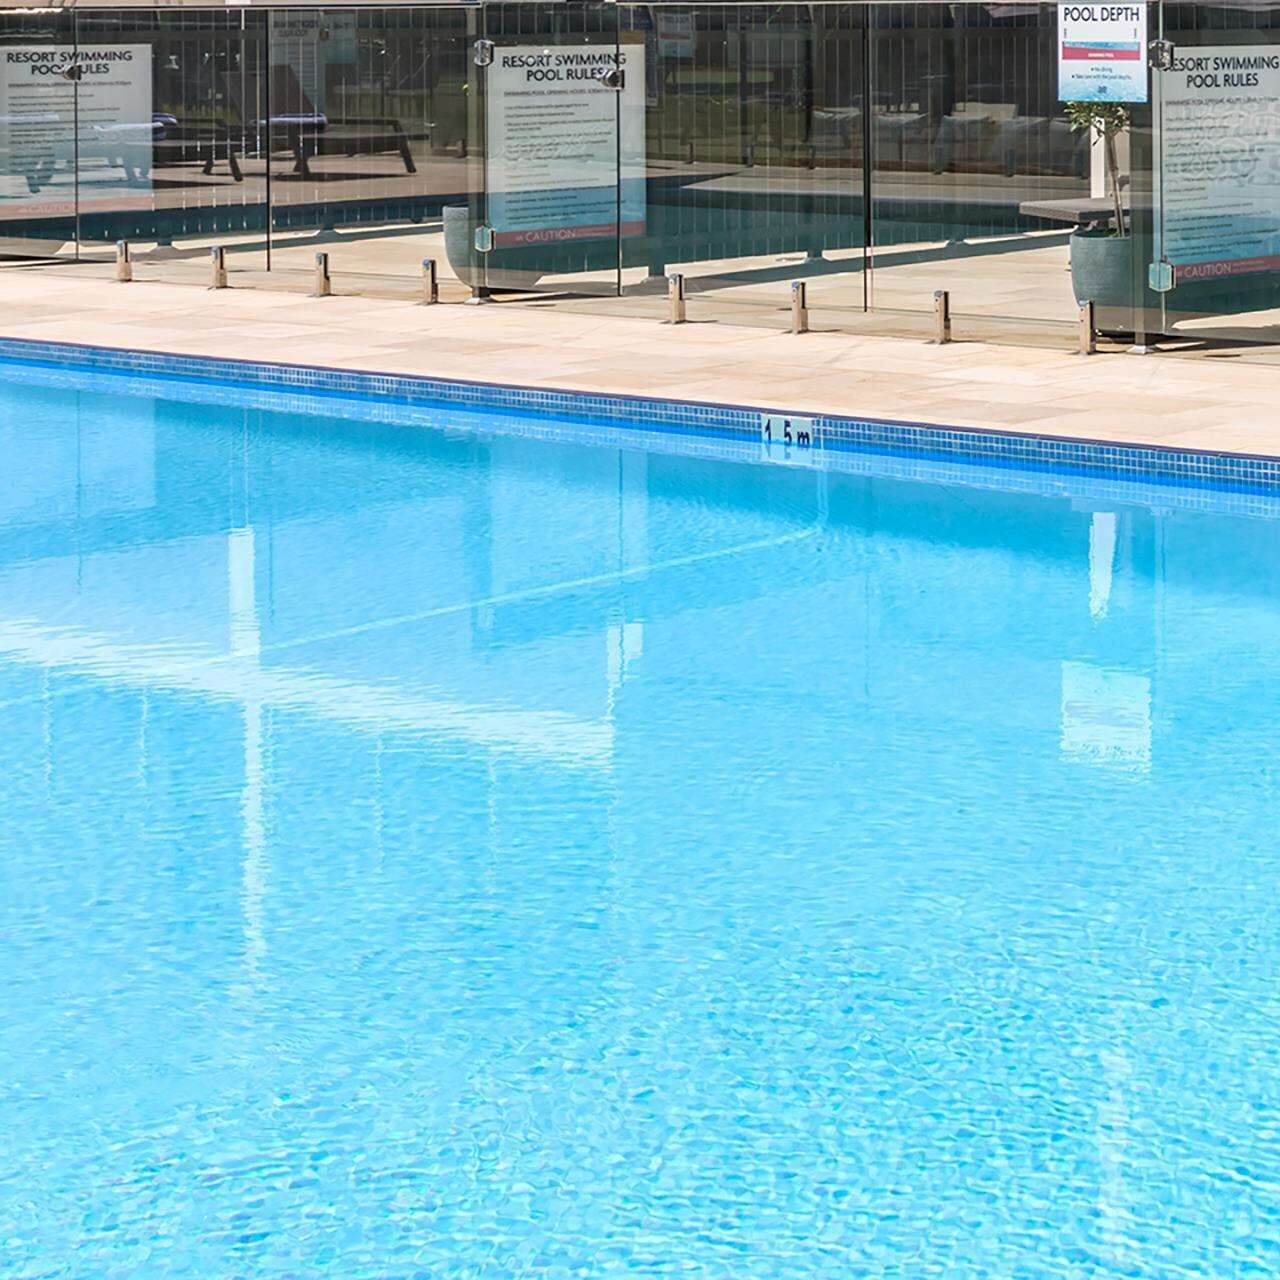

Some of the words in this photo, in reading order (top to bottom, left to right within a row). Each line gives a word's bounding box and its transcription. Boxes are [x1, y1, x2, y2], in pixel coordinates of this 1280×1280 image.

[1064, 7, 1098, 21] POOL
[1101, 7, 1139, 21] DEPTH
[7, 51, 56, 63] RESORT
[60, 51, 133, 62] SWIMMING
[502, 54, 552, 68] RESORT
[555, 53, 627, 66] SWIMMING
[1170, 56, 1210, 72] ESORT
[1213, 56, 1280, 70] SWIMMING
[31, 64, 64, 75] POO
[81, 63, 110, 74] ULES
[526, 69, 564, 82] POOL
[1186, 73, 1221, 88] POOL
[1223, 73, 1259, 87] RULES
[525, 228, 577, 242] CAUTION
[1184, 263, 1232, 278] CAUTION
